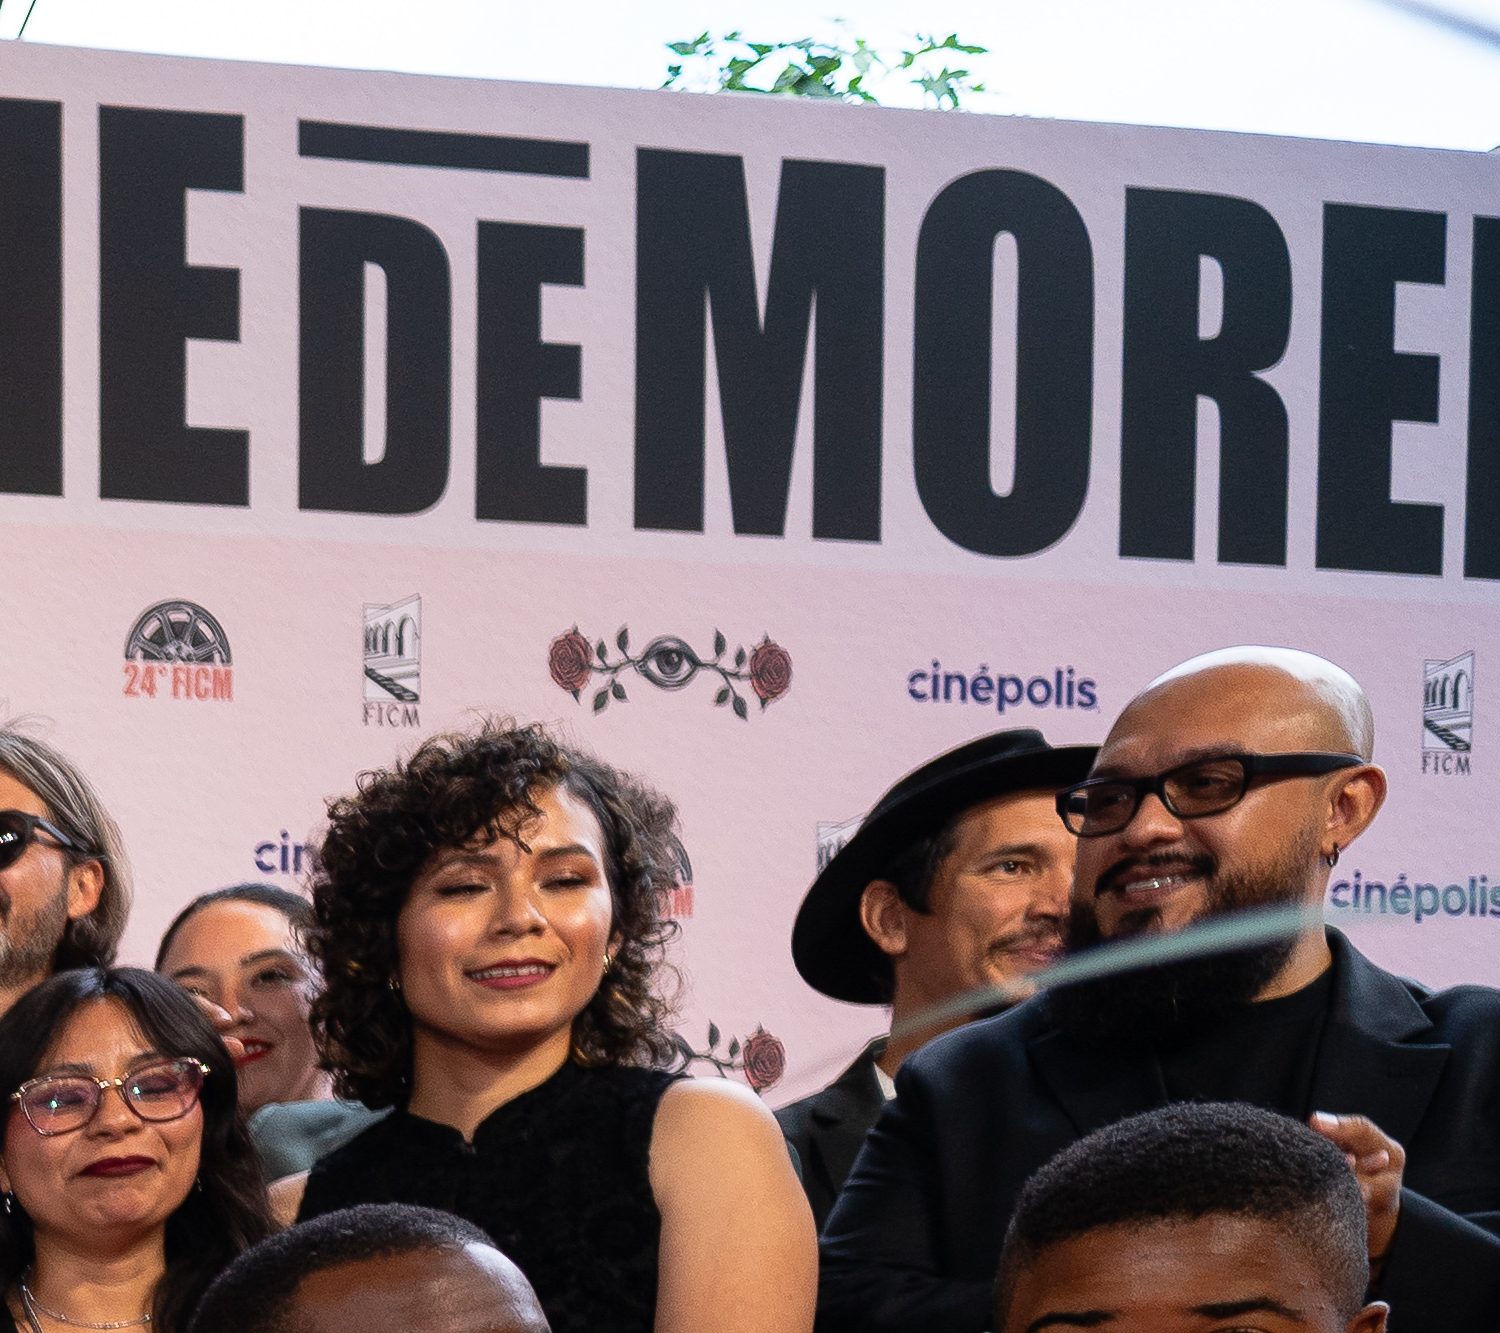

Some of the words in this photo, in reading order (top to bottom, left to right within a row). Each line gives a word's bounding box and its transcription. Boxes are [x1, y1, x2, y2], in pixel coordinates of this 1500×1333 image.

[298, 206, 588, 526] DE
[172, 665, 233, 702] FICM
[908, 660, 1098, 713] cinépolis
[363, 703, 420, 728] FICM
[1422, 754, 1471, 776] FICM
